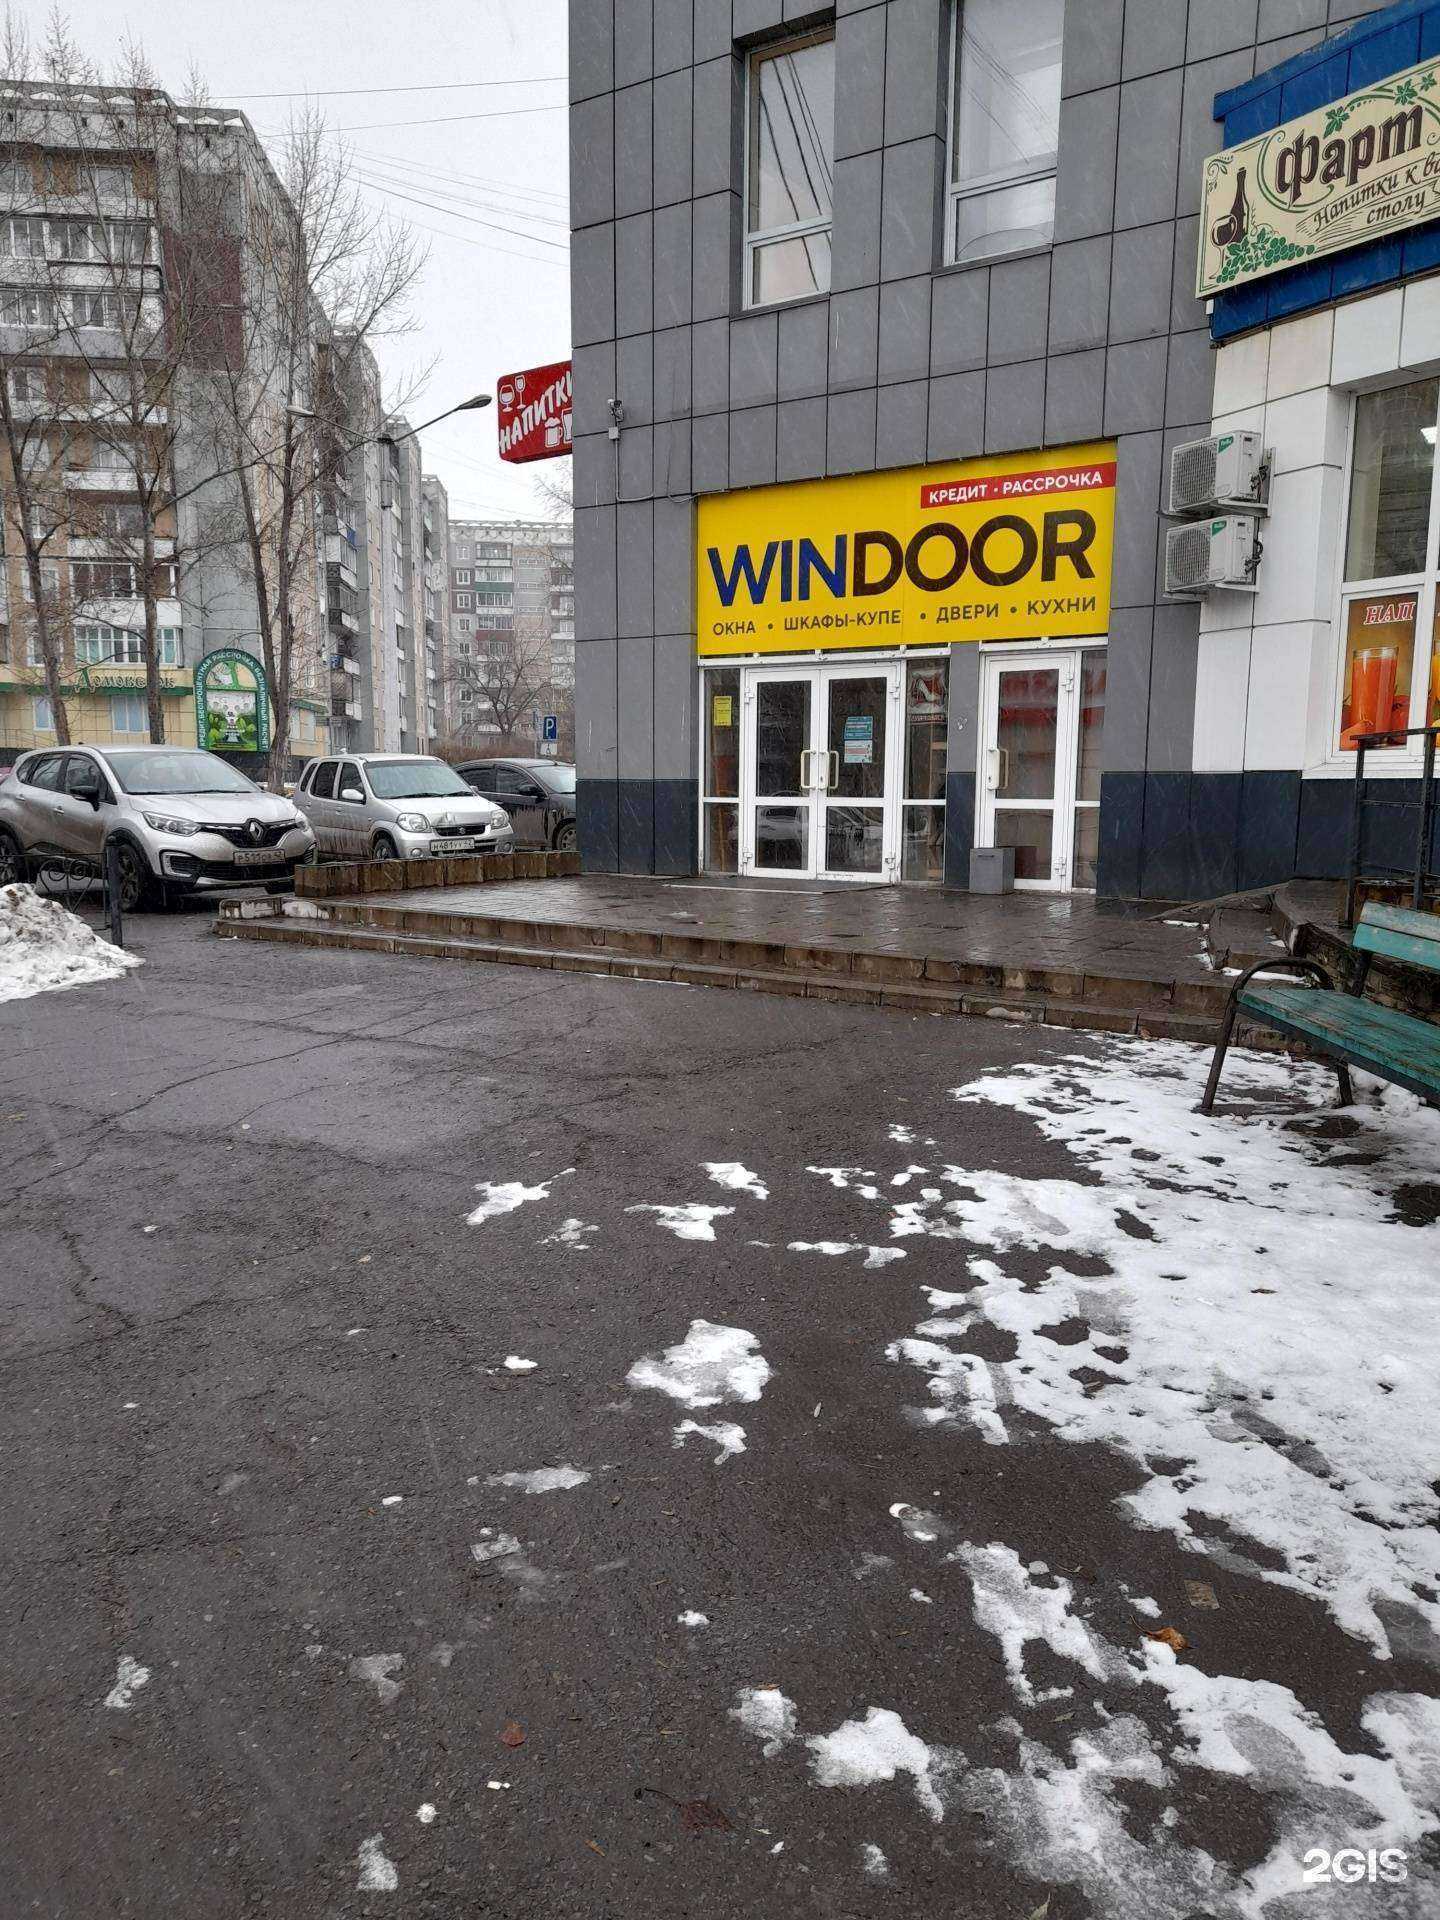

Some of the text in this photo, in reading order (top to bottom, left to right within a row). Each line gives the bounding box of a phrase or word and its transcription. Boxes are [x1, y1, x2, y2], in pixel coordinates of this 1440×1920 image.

[1314, 174, 1398, 231] Напитки
[1405, 165, 1421, 185] к
[1366, 190, 1426, 224] столу
[929, 471, 1103, 504] КРЕДИТ РАССРОЧКА
[706, 509, 1096, 607] WINDOOR
[713, 596, 1096, 636] ОКНА ШКАФЫ-КУПЕ ДВЕРИ КУХНИ
[1363, 601, 1416, 625] НАП
[545, 718, 554, 737] P
